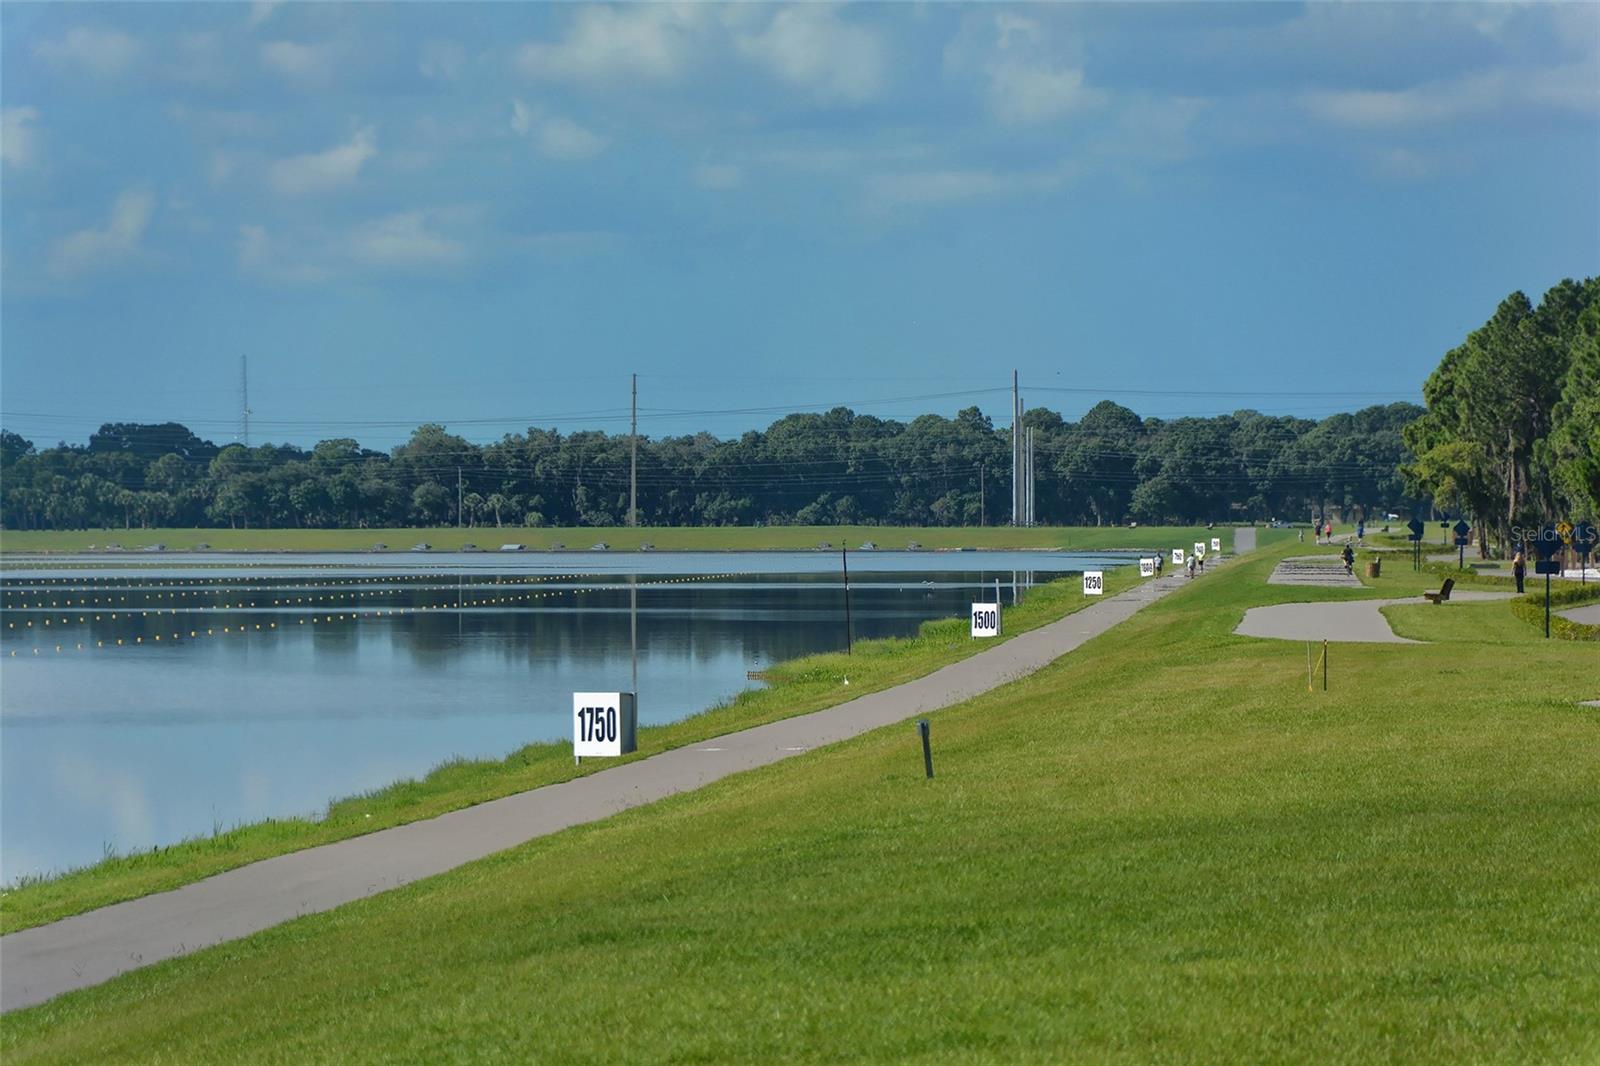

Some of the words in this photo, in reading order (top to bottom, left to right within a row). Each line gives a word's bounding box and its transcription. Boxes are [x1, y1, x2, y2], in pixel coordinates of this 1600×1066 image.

[1085, 576, 1102, 589] 1250
[973, 610, 996, 629] 1500
[577, 706, 617, 742] 1750
